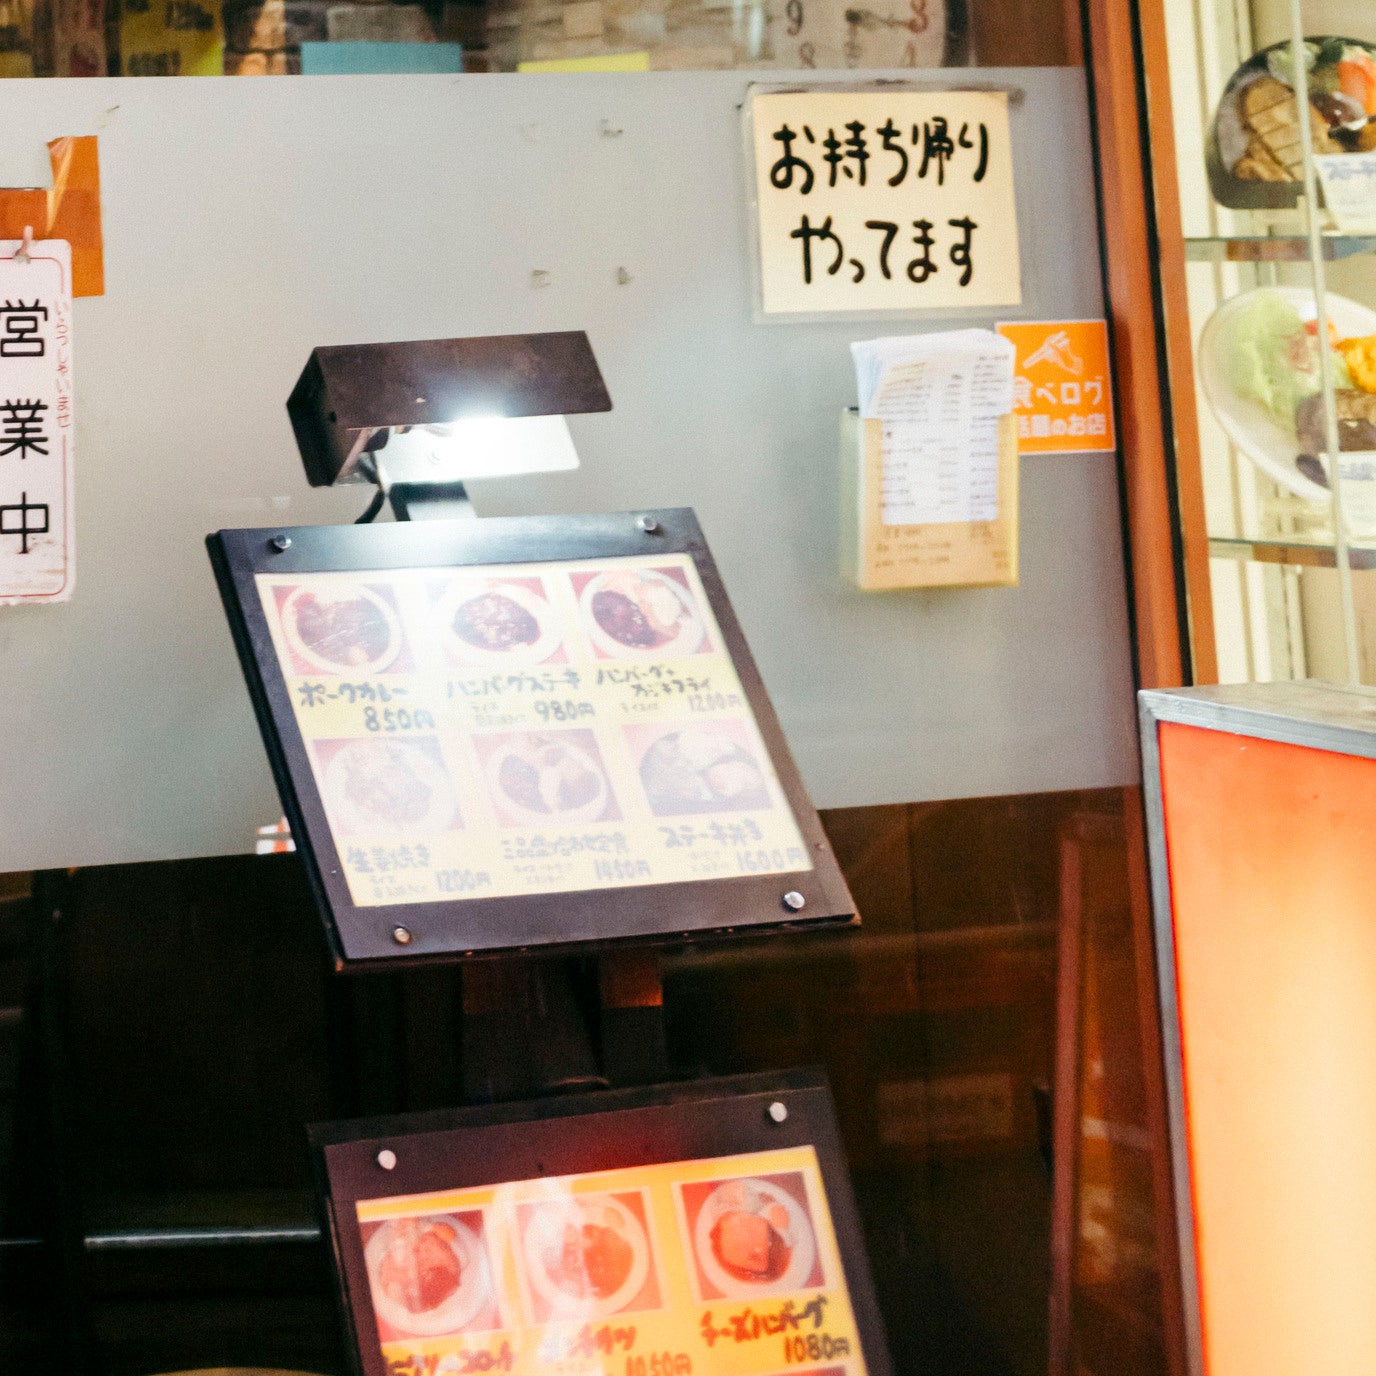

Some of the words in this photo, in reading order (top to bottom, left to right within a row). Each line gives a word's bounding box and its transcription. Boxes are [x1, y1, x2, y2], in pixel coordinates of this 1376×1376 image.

[769, 115, 989, 195] お持ち帰り
[790, 214, 979, 287] やってます
[1012, 374, 1103, 409] 食べログ
[363, 705, 436, 733] 850円
[533, 699, 596, 724] 980円
[782, 1332, 851, 1365] 1080円
